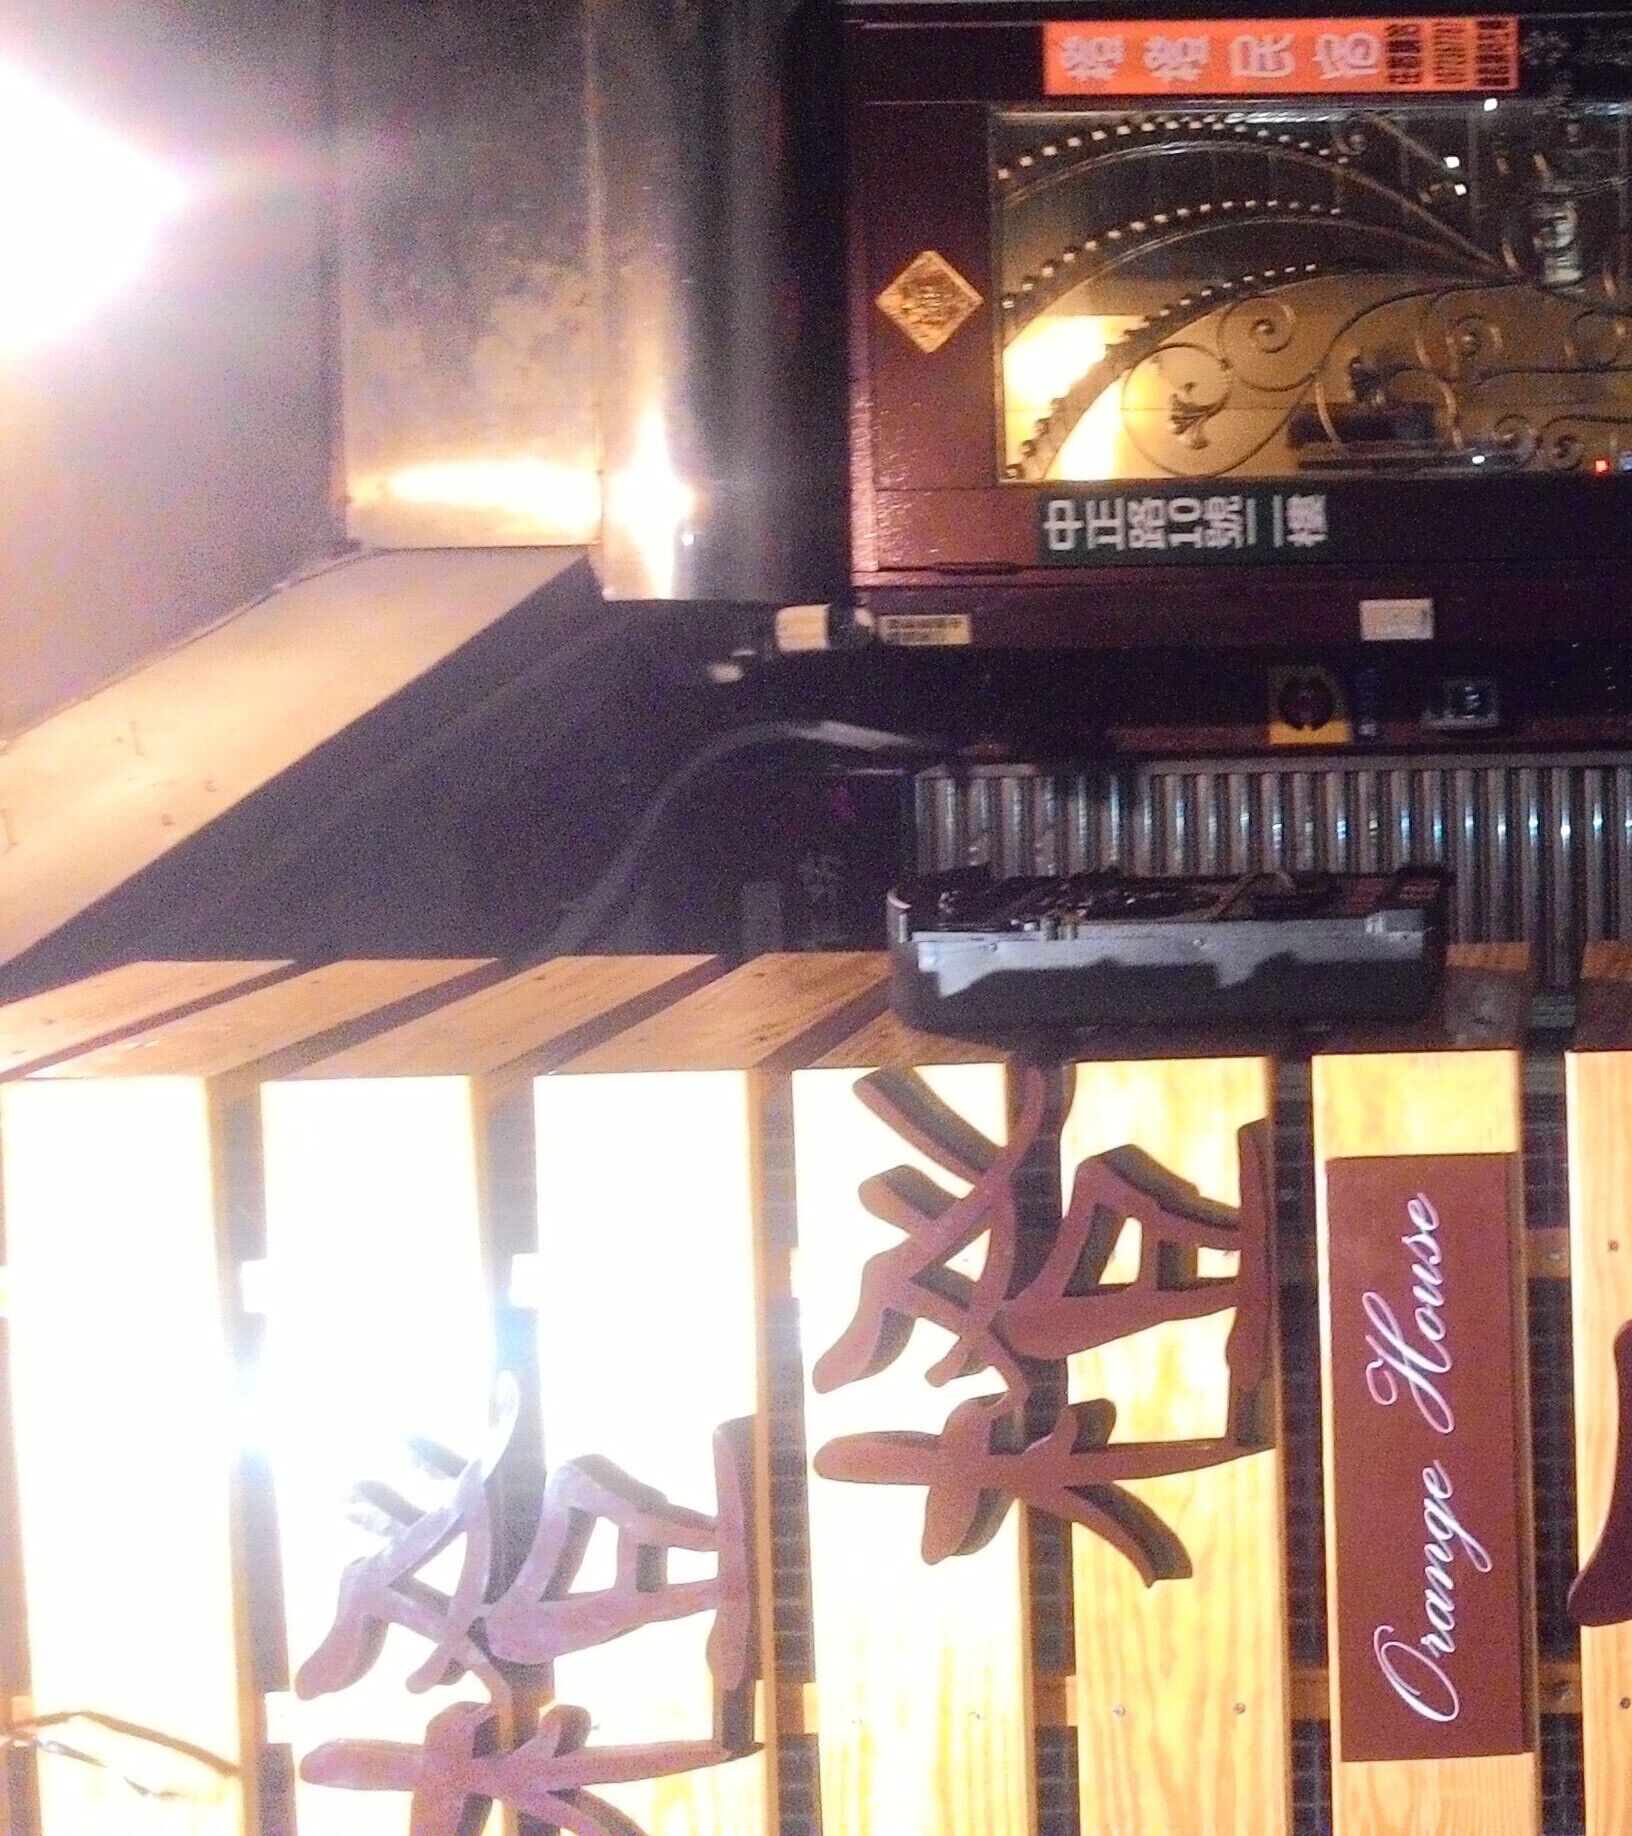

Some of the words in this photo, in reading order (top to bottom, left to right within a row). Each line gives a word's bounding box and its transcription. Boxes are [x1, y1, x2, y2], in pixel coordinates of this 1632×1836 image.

[1043, 496, 1327, 551] 中正路10號二樓
[1363, 1195, 1456, 1434] House
[1372, 1462, 1493, 1722] Orange
